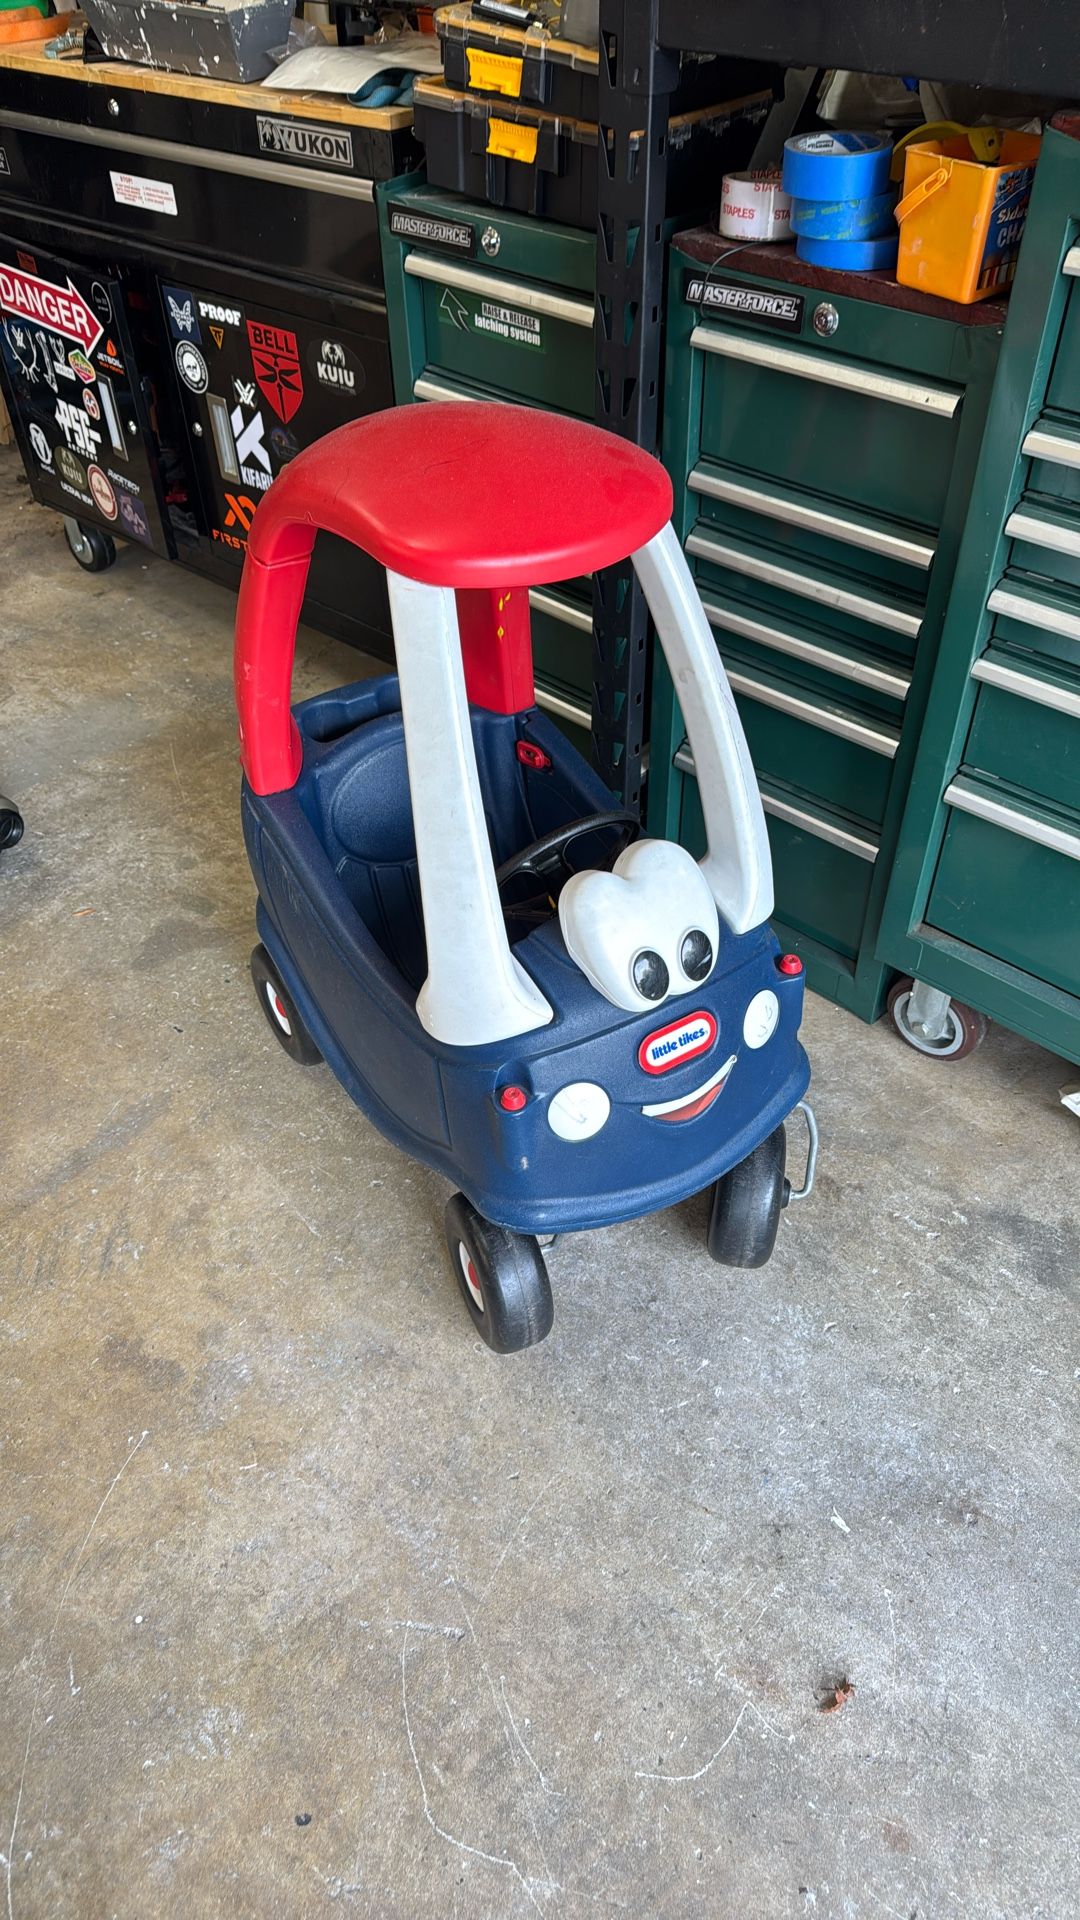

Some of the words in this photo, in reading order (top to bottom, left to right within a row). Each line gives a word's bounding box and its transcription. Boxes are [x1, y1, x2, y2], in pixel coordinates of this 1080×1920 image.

[278, 127, 349, 161] YUKON
[751, 168, 784, 179] STAPLE
[723, 203, 756, 220] STAPLES
[0, 272, 92, 338] DANGER
[198, 301, 241, 326] PROOF
[483, 304, 501, 320] RAISE
[503, 311, 508, 321] &
[509, 311, 537, 330] RELEASE
[251, 325, 296, 355] BELL
[475, 313, 509, 338] latching
[510, 326, 541, 347] system
[317, 361, 355, 387] KUIU
[61, 462, 83, 484] KUIU
[240, 465, 274, 491] KIFARU
[212, 529, 249, 551] FIRST
[652, 1041, 678, 1060] little
[678, 1027, 705, 1047] tikes
